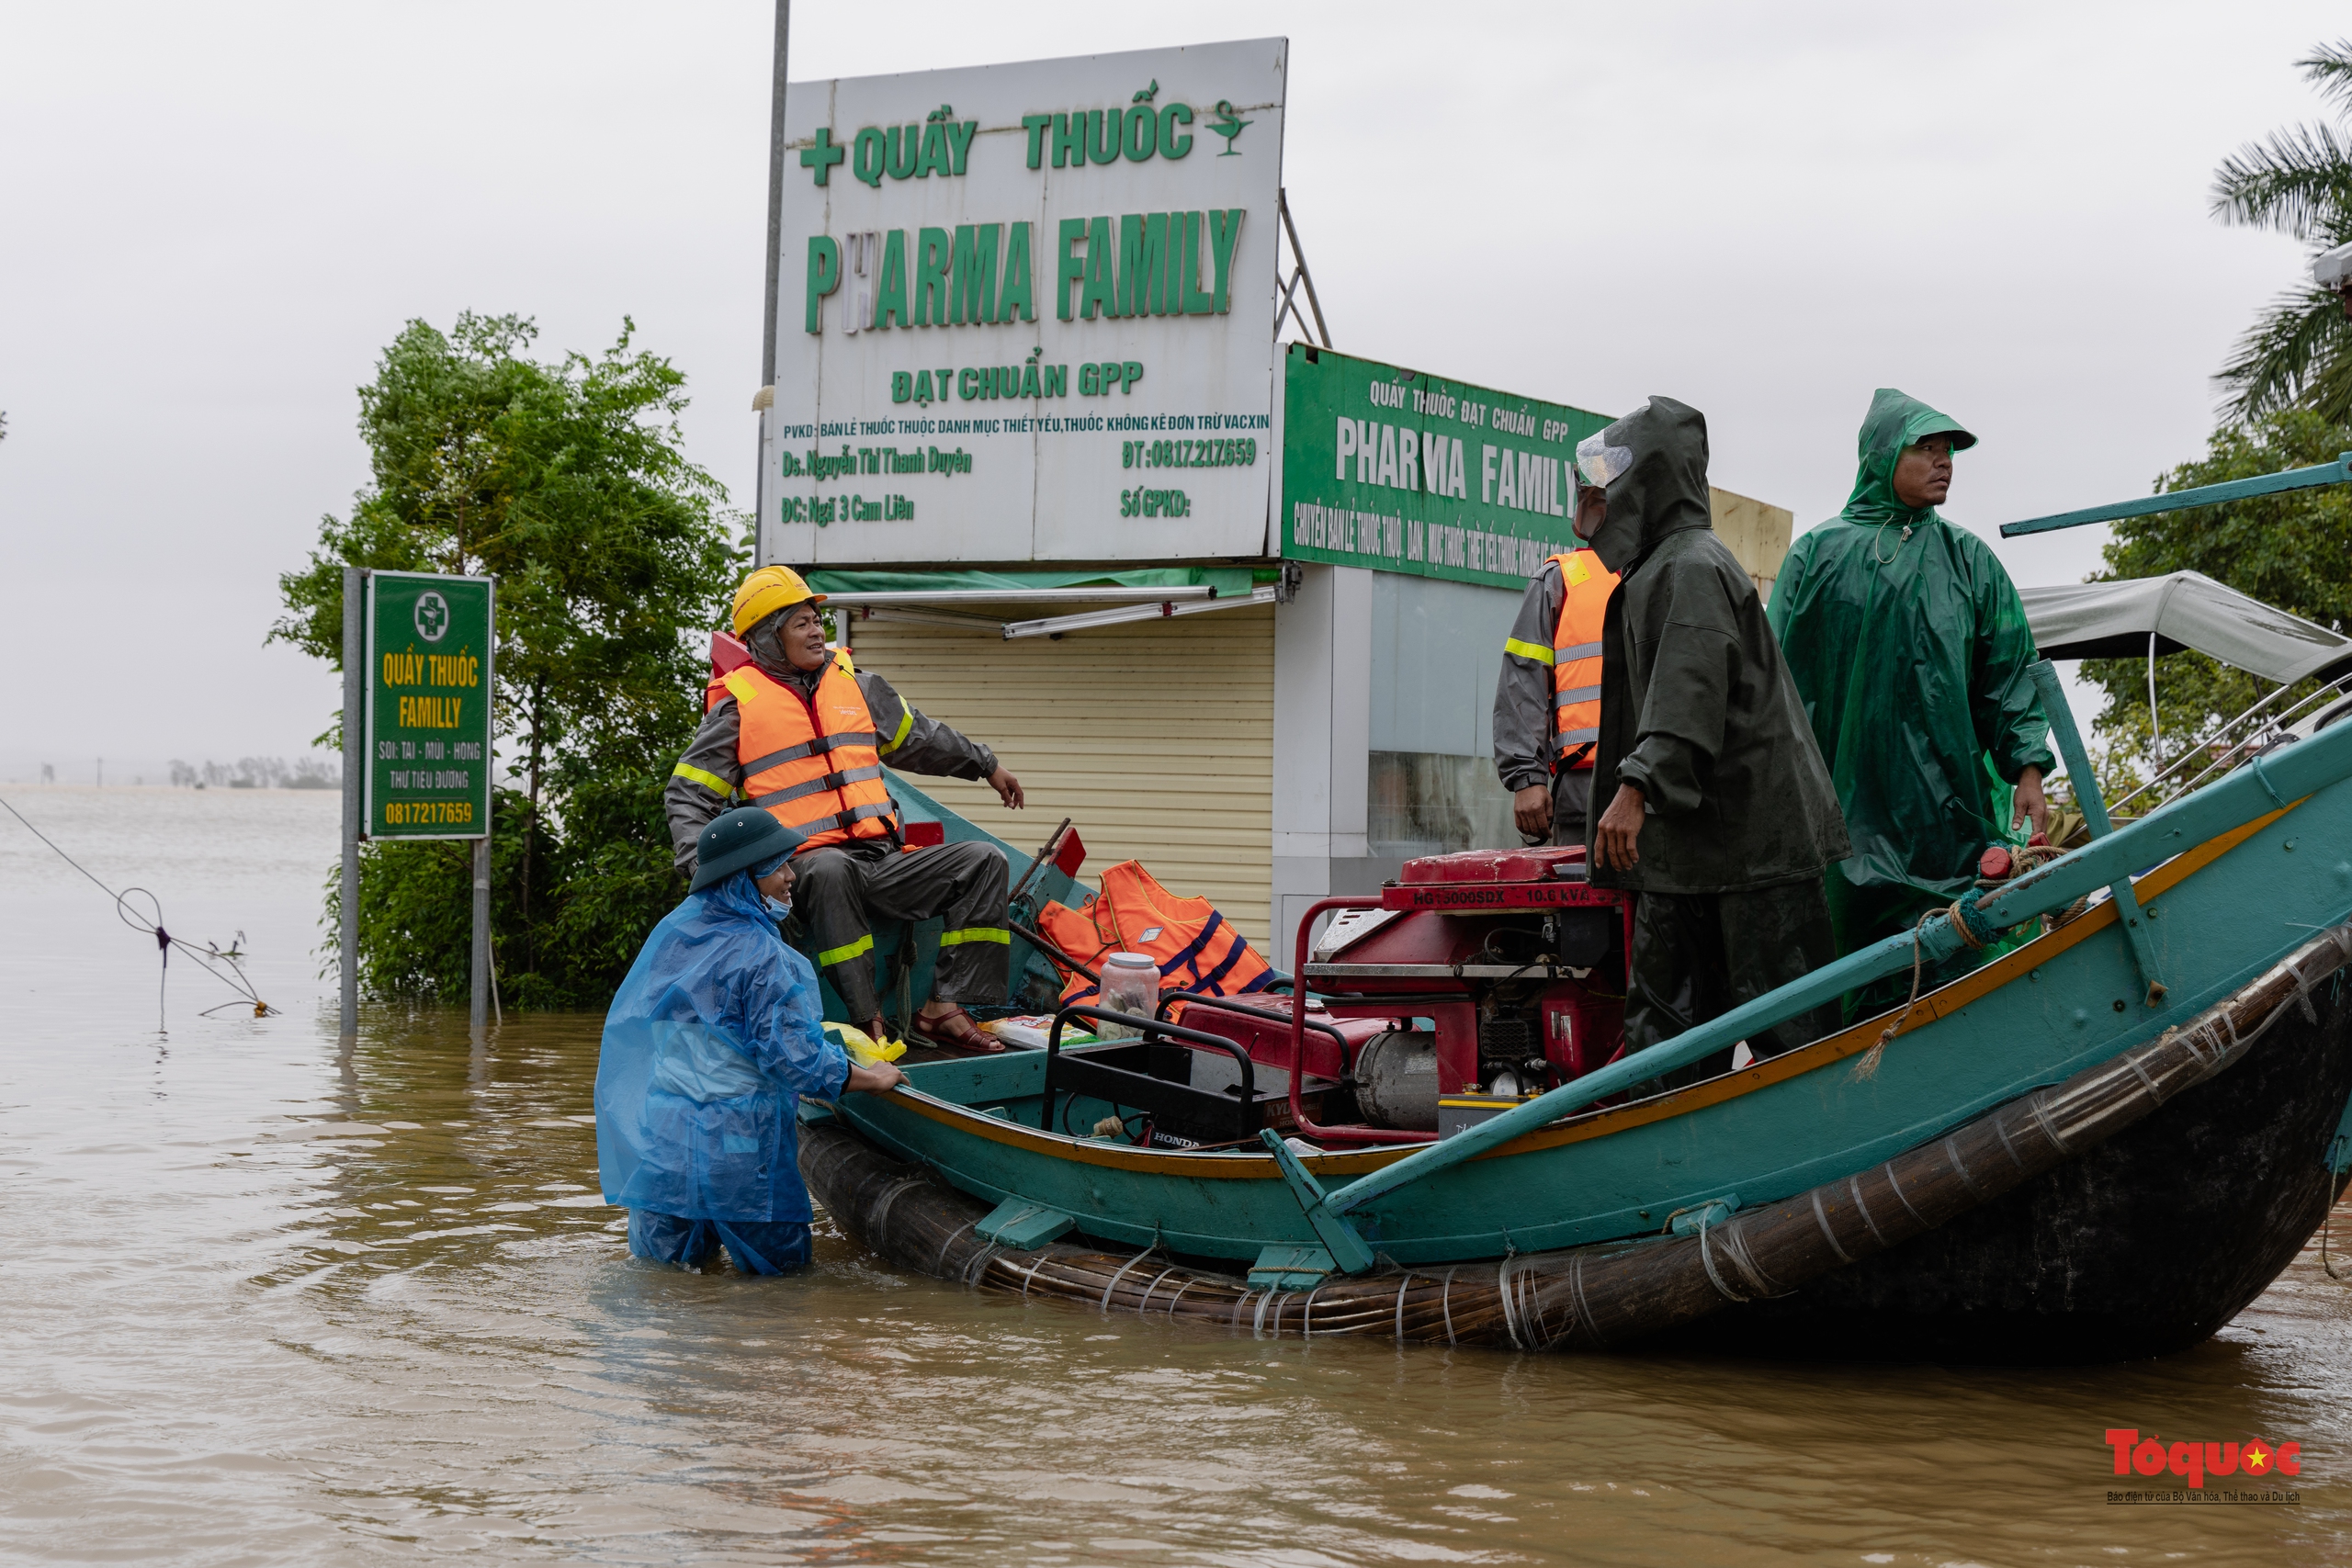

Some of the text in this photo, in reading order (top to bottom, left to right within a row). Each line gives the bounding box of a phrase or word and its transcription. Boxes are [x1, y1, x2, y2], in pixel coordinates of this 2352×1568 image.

[853, 78, 1193, 187] QUẦY THUỐC
[805, 208, 1247, 334] PHARMA FAMILY
[891, 346, 1144, 407] ĐẠT CHUẨN GPP
[784, 423, 817, 439] PVKD:
[860, 415, 895, 435] THUỐC
[898, 417, 935, 436] THUỘC
[938, 419, 970, 434] DANH
[973, 419, 1000, 436] MỤC
[1003, 413, 1035, 433] THIẾT
[1106, 413, 1148, 431] KHÔNG
[1151, 413, 1166, 431] KÊ
[1168, 413, 1194, 430] ĐƠN
[1197, 412, 1224, 430] TRỪ
[1224, 414, 1270, 429] VACXIN
[1412, 385, 1455, 419] THUỐC
[1461, 400, 1487, 429] ĐẠT
[1492, 404, 1535, 437] CHUẨN
[1543, 419, 1568, 443] GPP
[806, 445, 856, 480] Nguyễn
[882, 446, 925, 474] Thanh
[928, 446, 972, 477] Duyên
[1336, 416, 1577, 519] PHARMA FAMILY
[808, 496, 835, 527] Ngã
[839, 494, 849, 521] 3
[851, 494, 882, 521] Cam
[884, 494, 914, 521] Liên
[1120, 485, 1191, 517] Số GPKD:
[429, 645, 479, 687] THUỐC
[399, 696, 461, 728] FAMILLY
[401, 740, 415, 761] TAI
[453, 741, 481, 764] HỌNG
[386, 802, 472, 825] 0817217659
[1561, 887, 1590, 902] kVA
